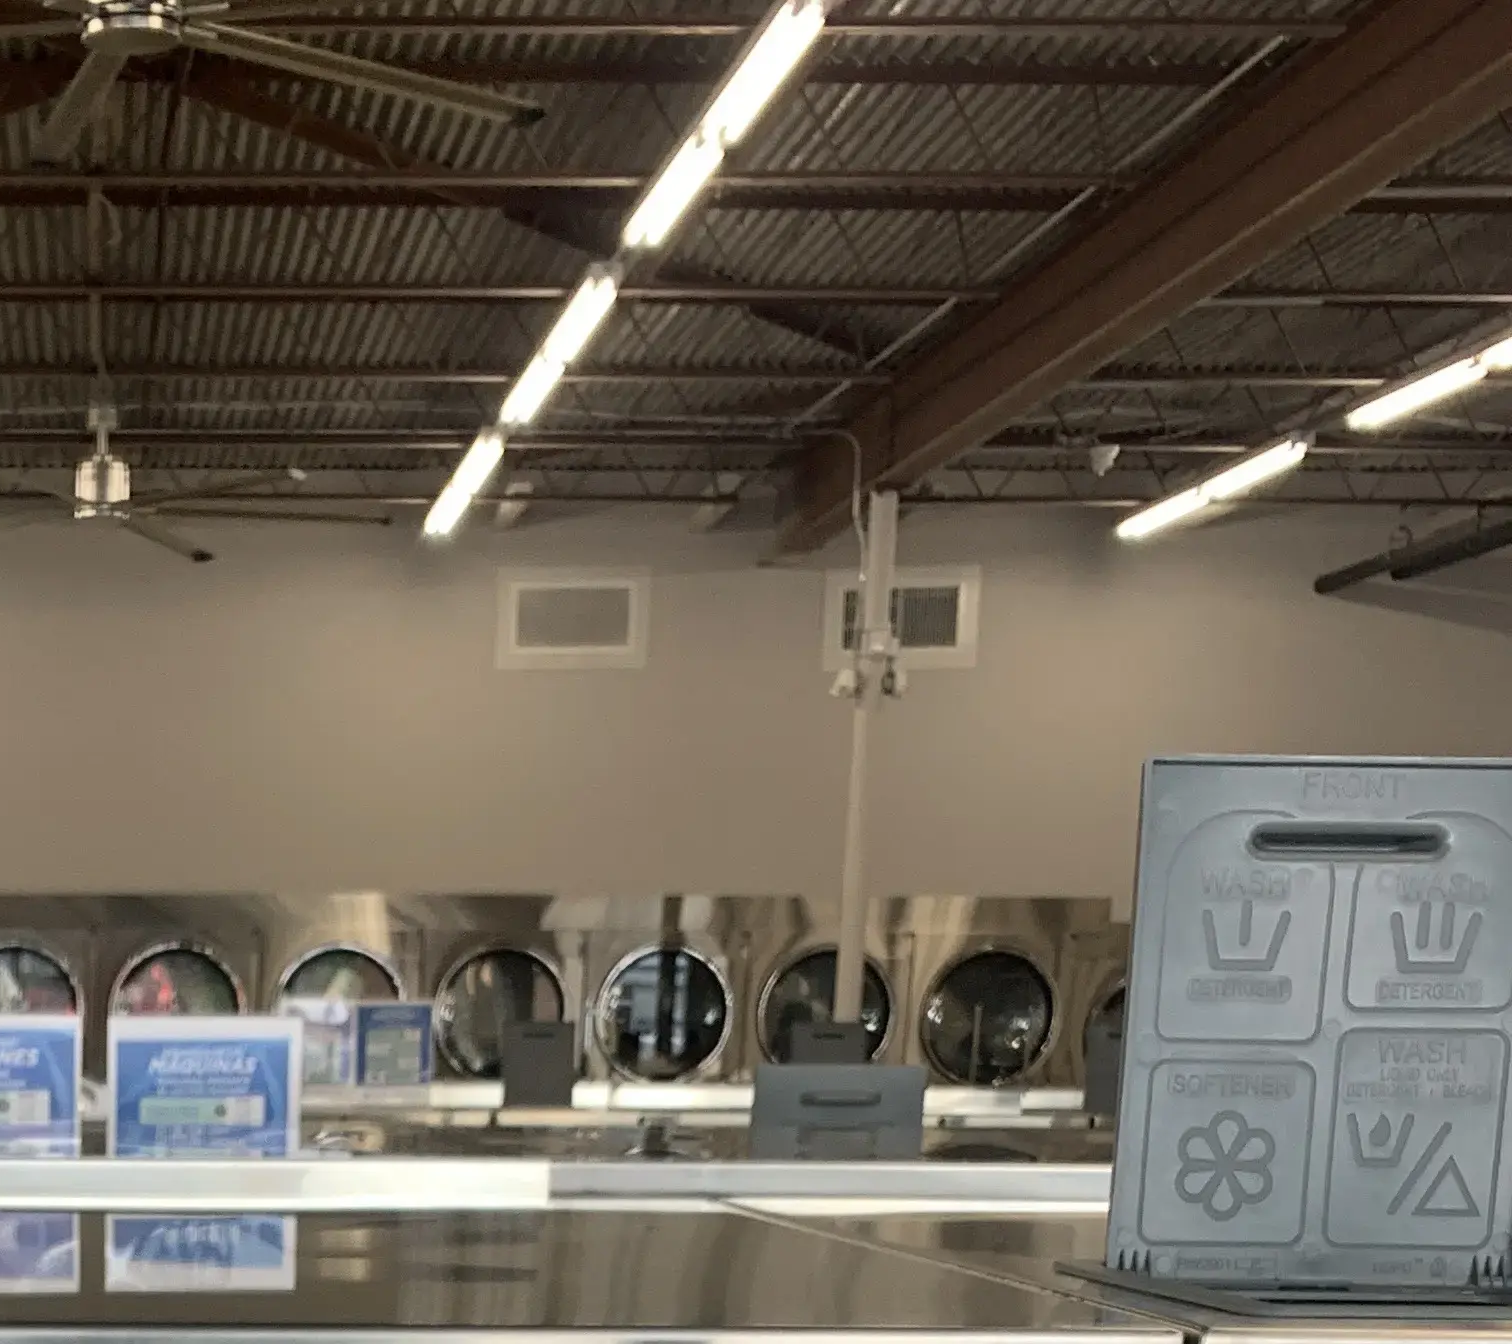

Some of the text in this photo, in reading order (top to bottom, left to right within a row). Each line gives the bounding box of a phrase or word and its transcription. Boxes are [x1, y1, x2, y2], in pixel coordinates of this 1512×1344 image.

[1301, 773, 1405, 801] FRONT
[1378, 1038, 1466, 1064] WASH
[1170, 1073, 1295, 1097] SOFTENER
